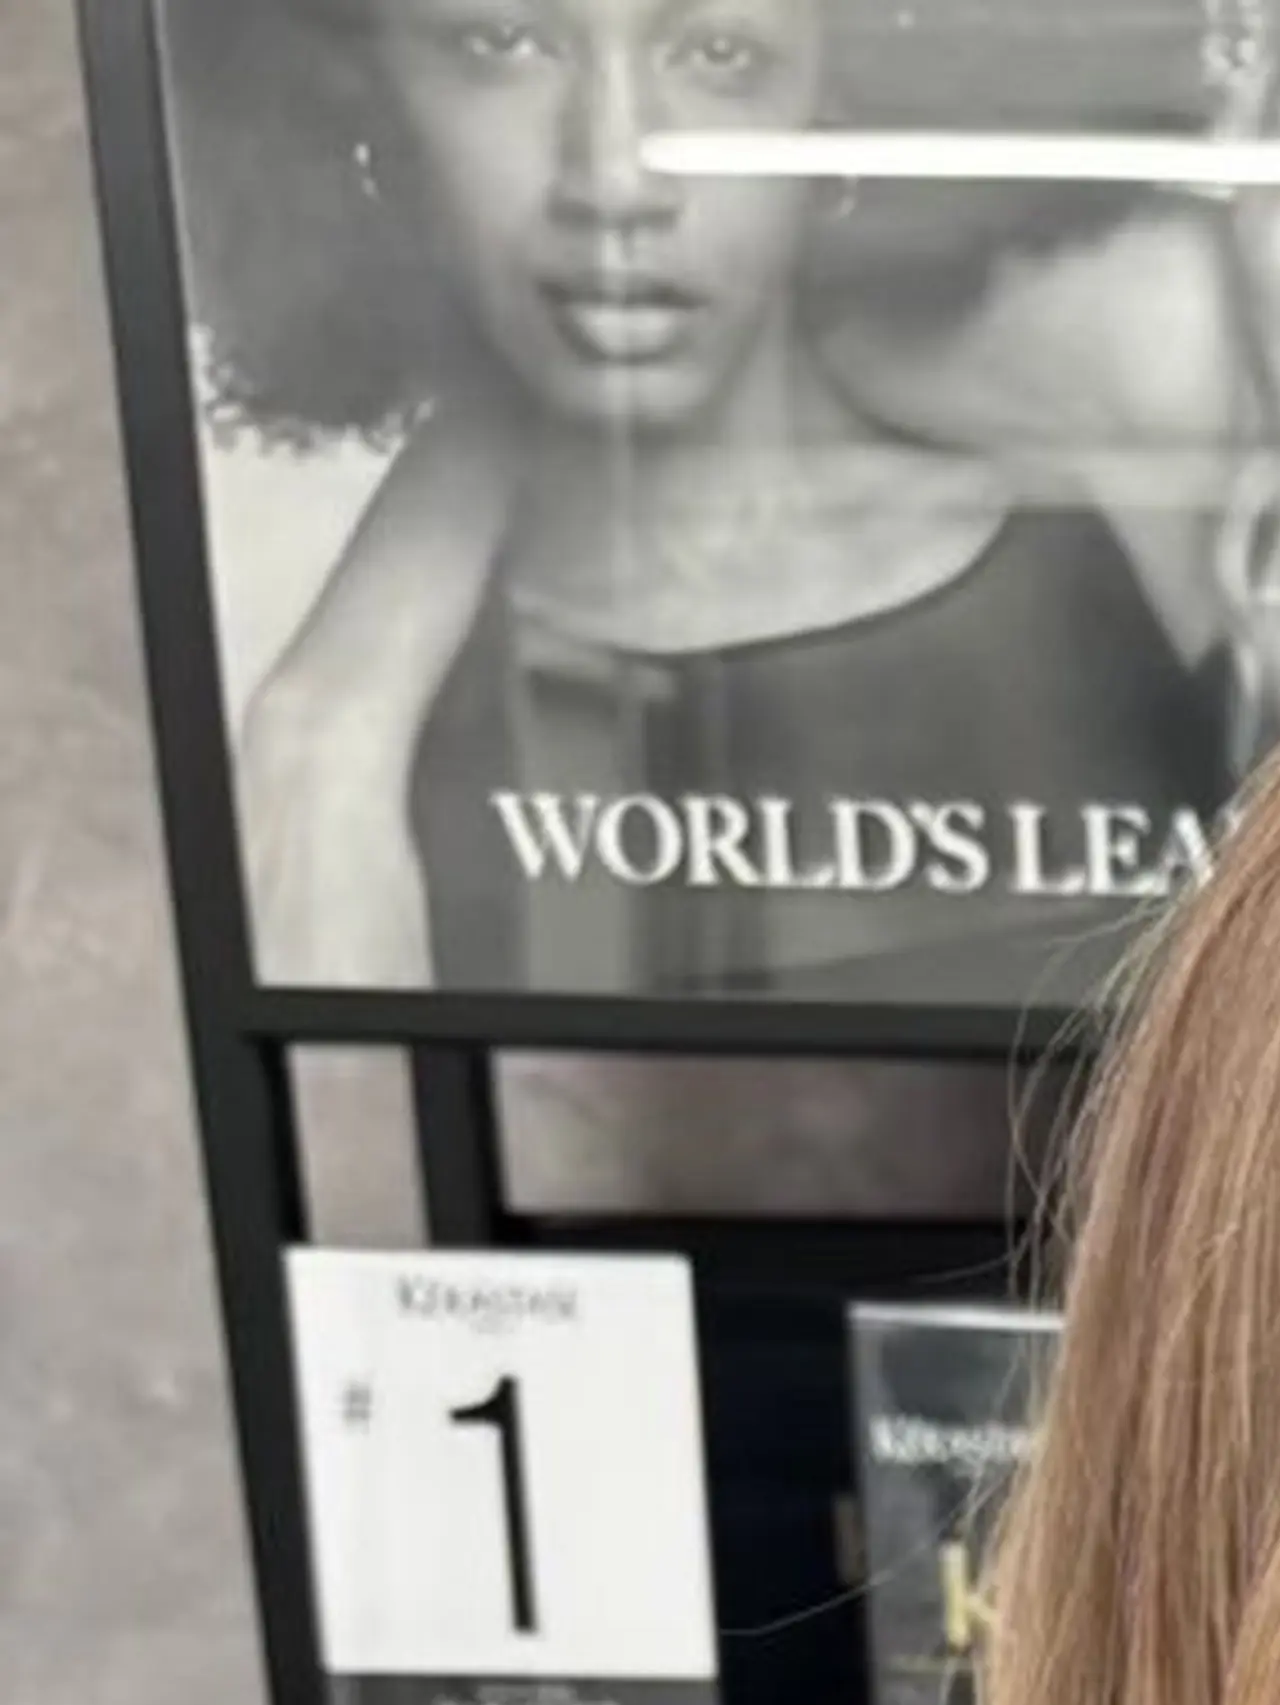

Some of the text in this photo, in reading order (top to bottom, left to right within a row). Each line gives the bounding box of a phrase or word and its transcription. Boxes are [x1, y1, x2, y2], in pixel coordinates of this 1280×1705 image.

[491, 790, 990, 893] WORLD'S
[1008, 802, 1214, 896] LEA
[449, 1374, 539, 1636] 1
